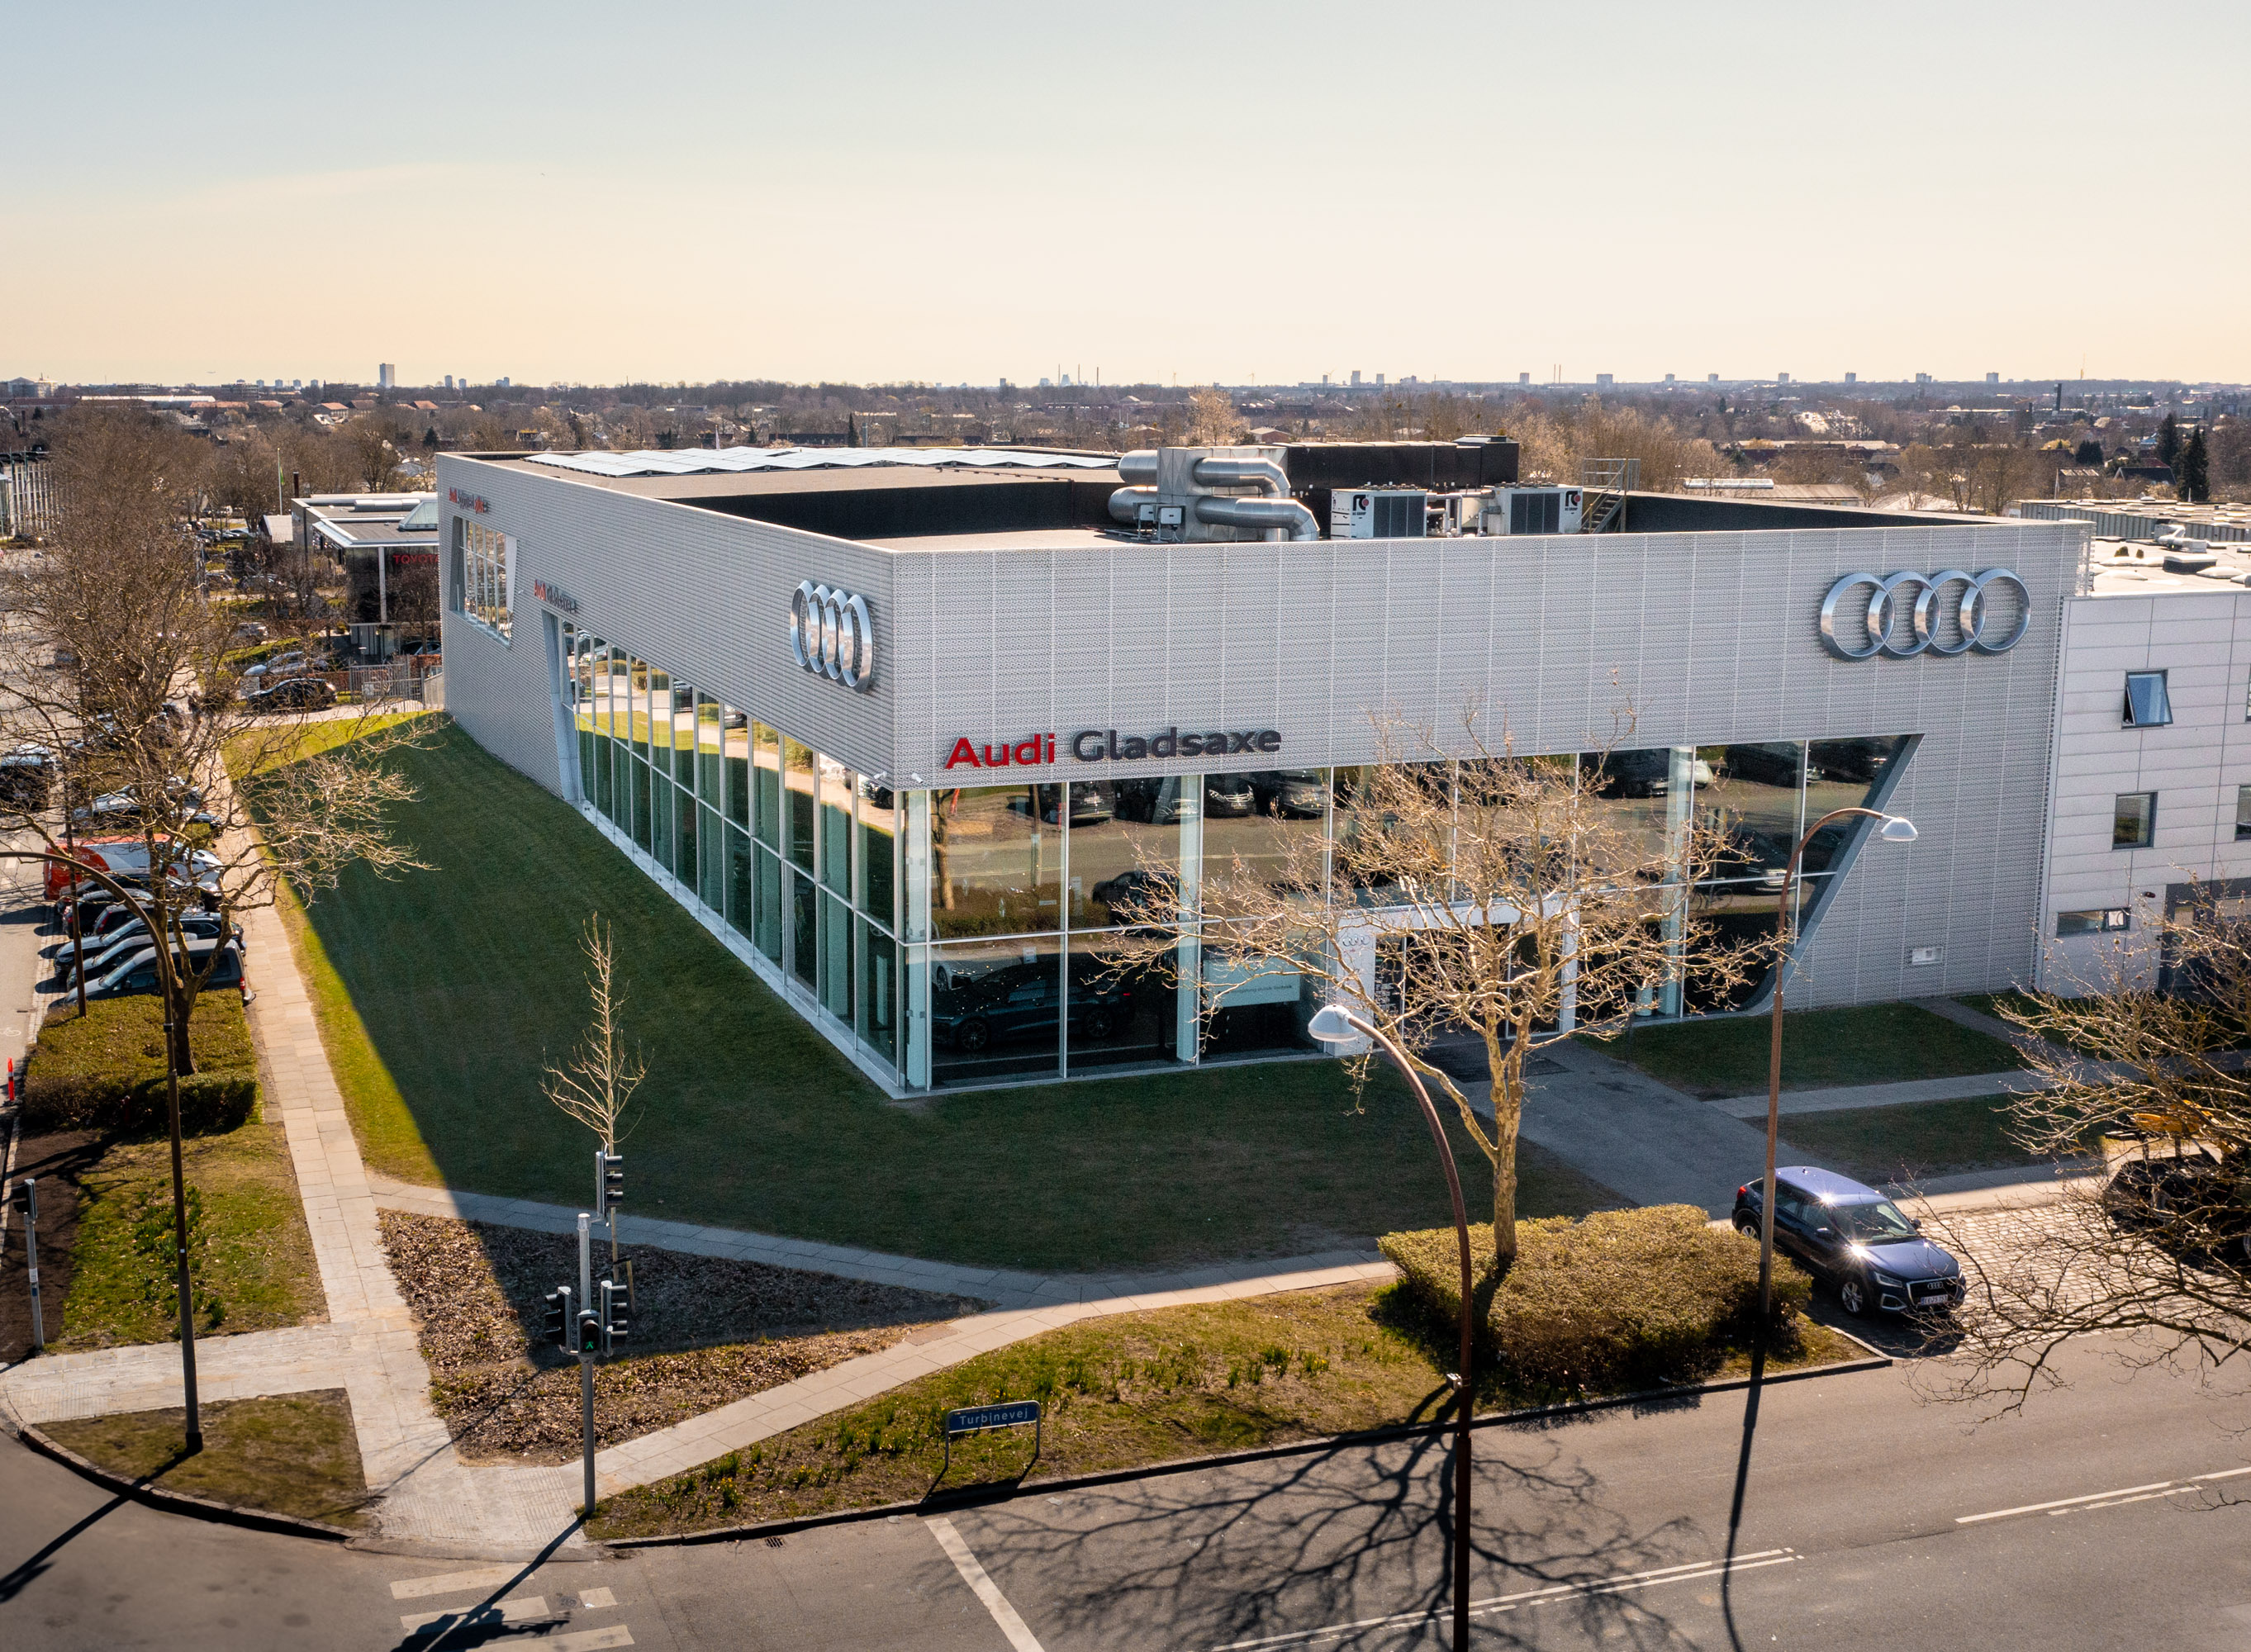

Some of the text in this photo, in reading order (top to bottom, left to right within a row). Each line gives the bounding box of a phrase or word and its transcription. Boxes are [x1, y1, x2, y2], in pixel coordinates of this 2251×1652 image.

[943, 726, 1283, 770] Audi Gladsaxe
[959, 1408, 1028, 1426] Turbinevej
